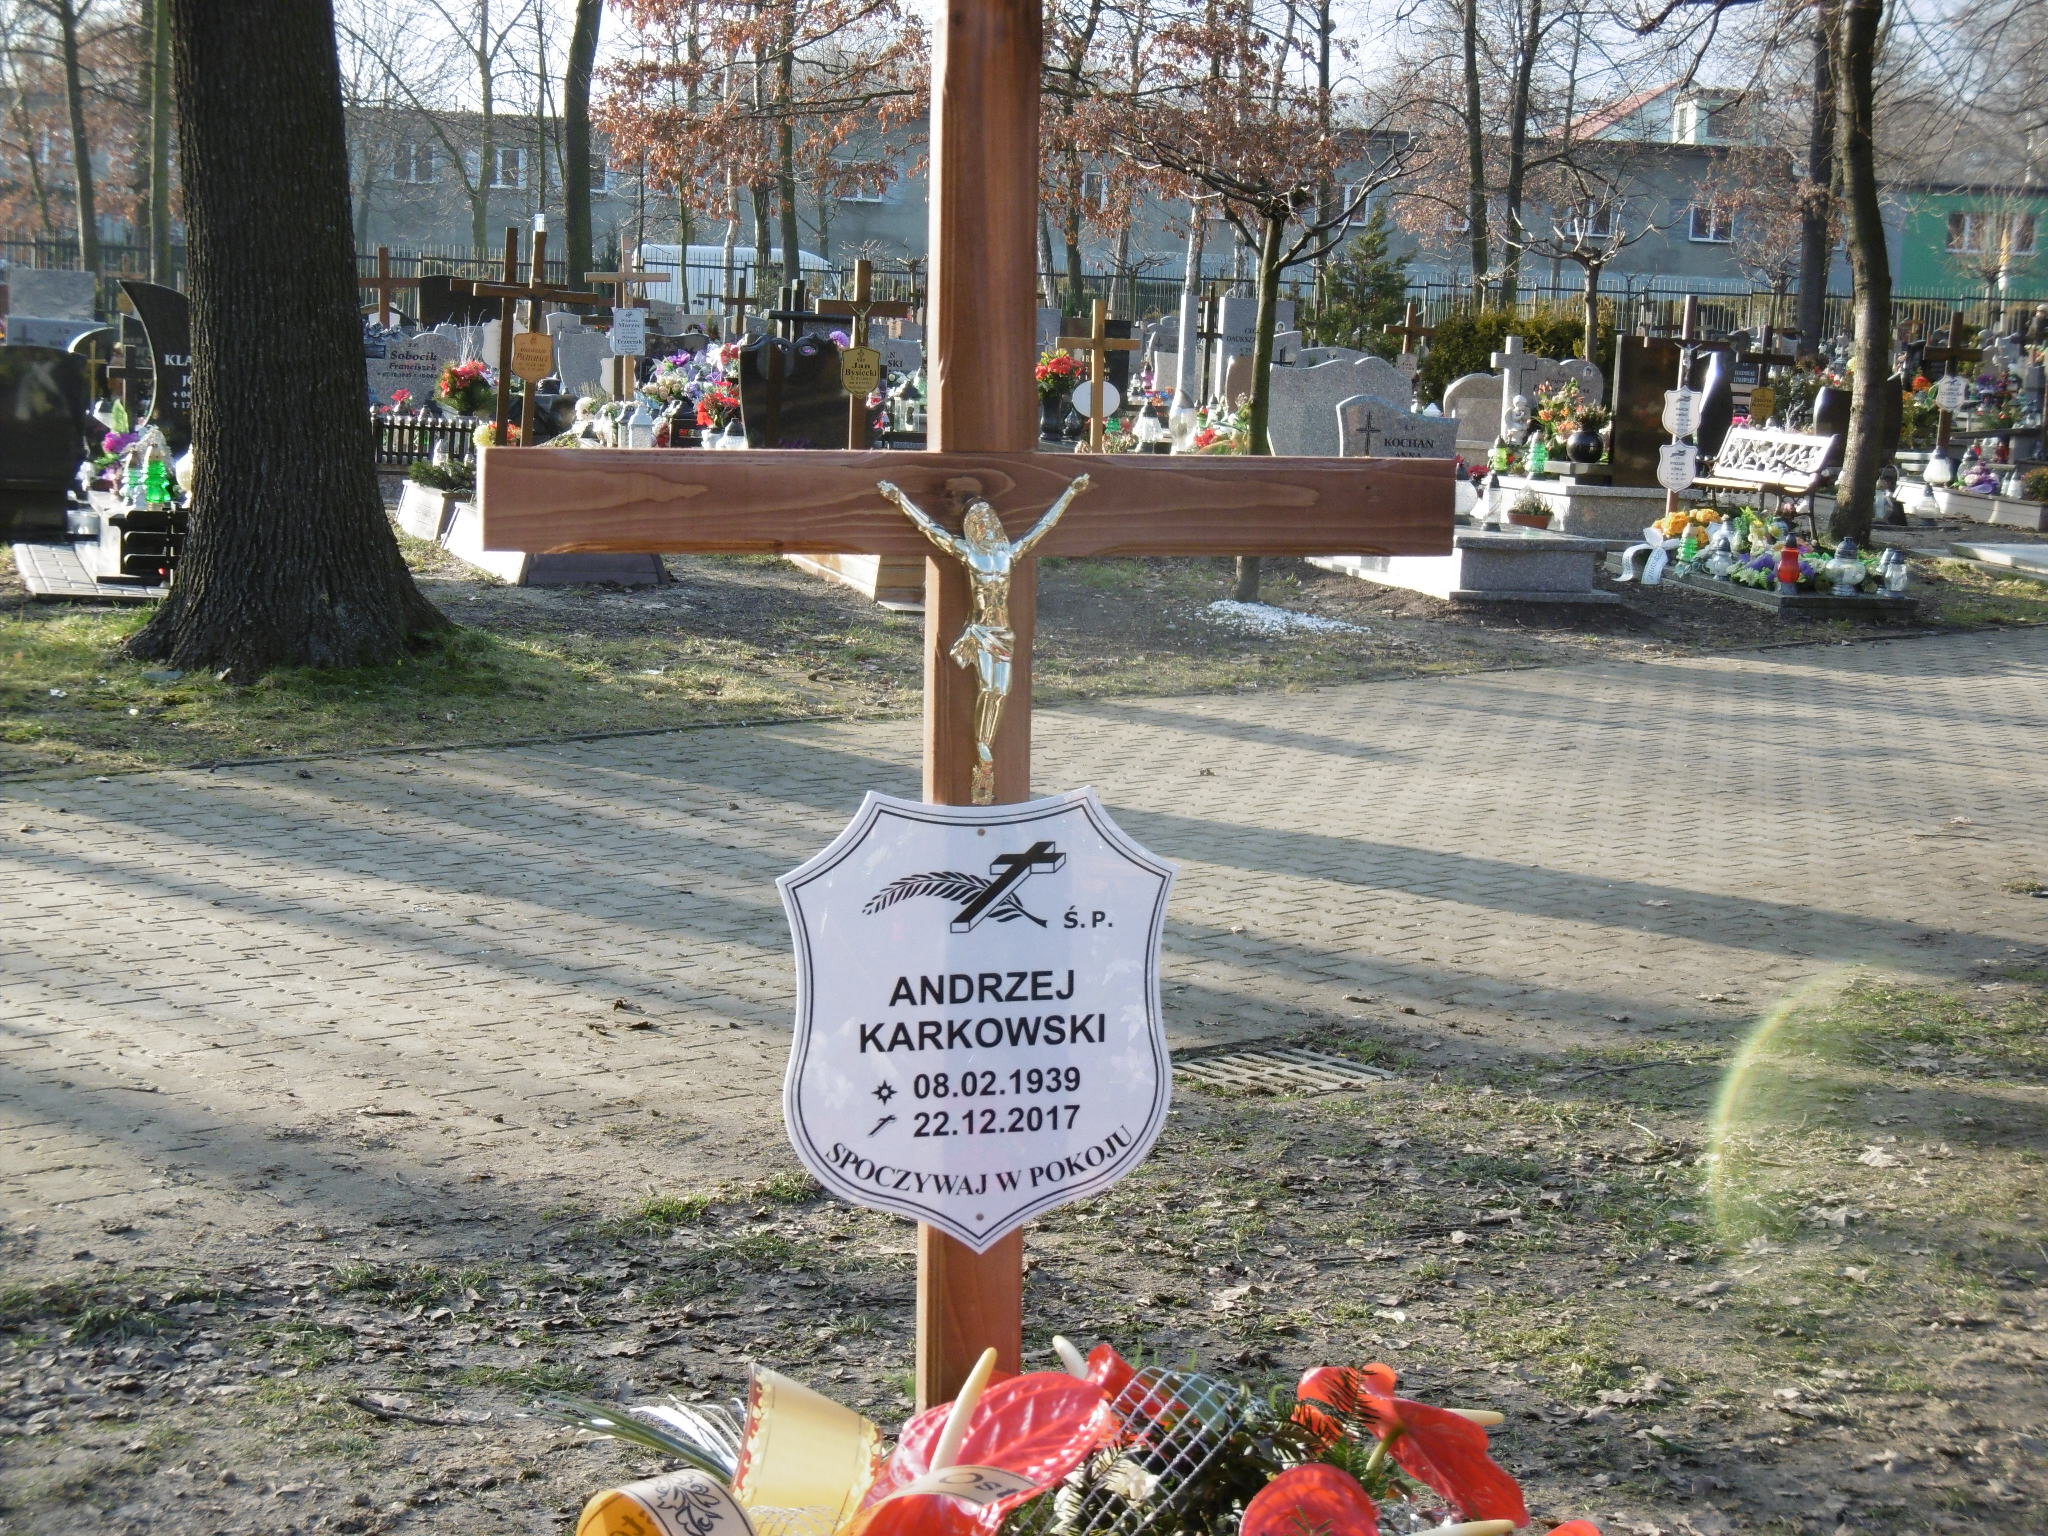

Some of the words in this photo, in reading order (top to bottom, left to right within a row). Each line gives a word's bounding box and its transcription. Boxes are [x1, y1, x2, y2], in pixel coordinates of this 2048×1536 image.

[164, 354, 191, 366] KLA
[389, 362, 437, 371] Franciszek
[390, 350, 438, 361] Sobocik
[1384, 438, 1435, 449] KOCHAN
[889, 969, 1076, 1007] ANDRZEJ
[859, 1013, 1106, 1053] KARKOWSKI
[912, 1066, 1081, 1100] 08.02.1939
[912, 1104, 1081, 1138] 22.12.2017
[825, 1142, 987, 1196] SPOCZYWAJ
[994, 1168, 1022, 1192] W
[1030, 1124, 1133, 1188] POKOJU
